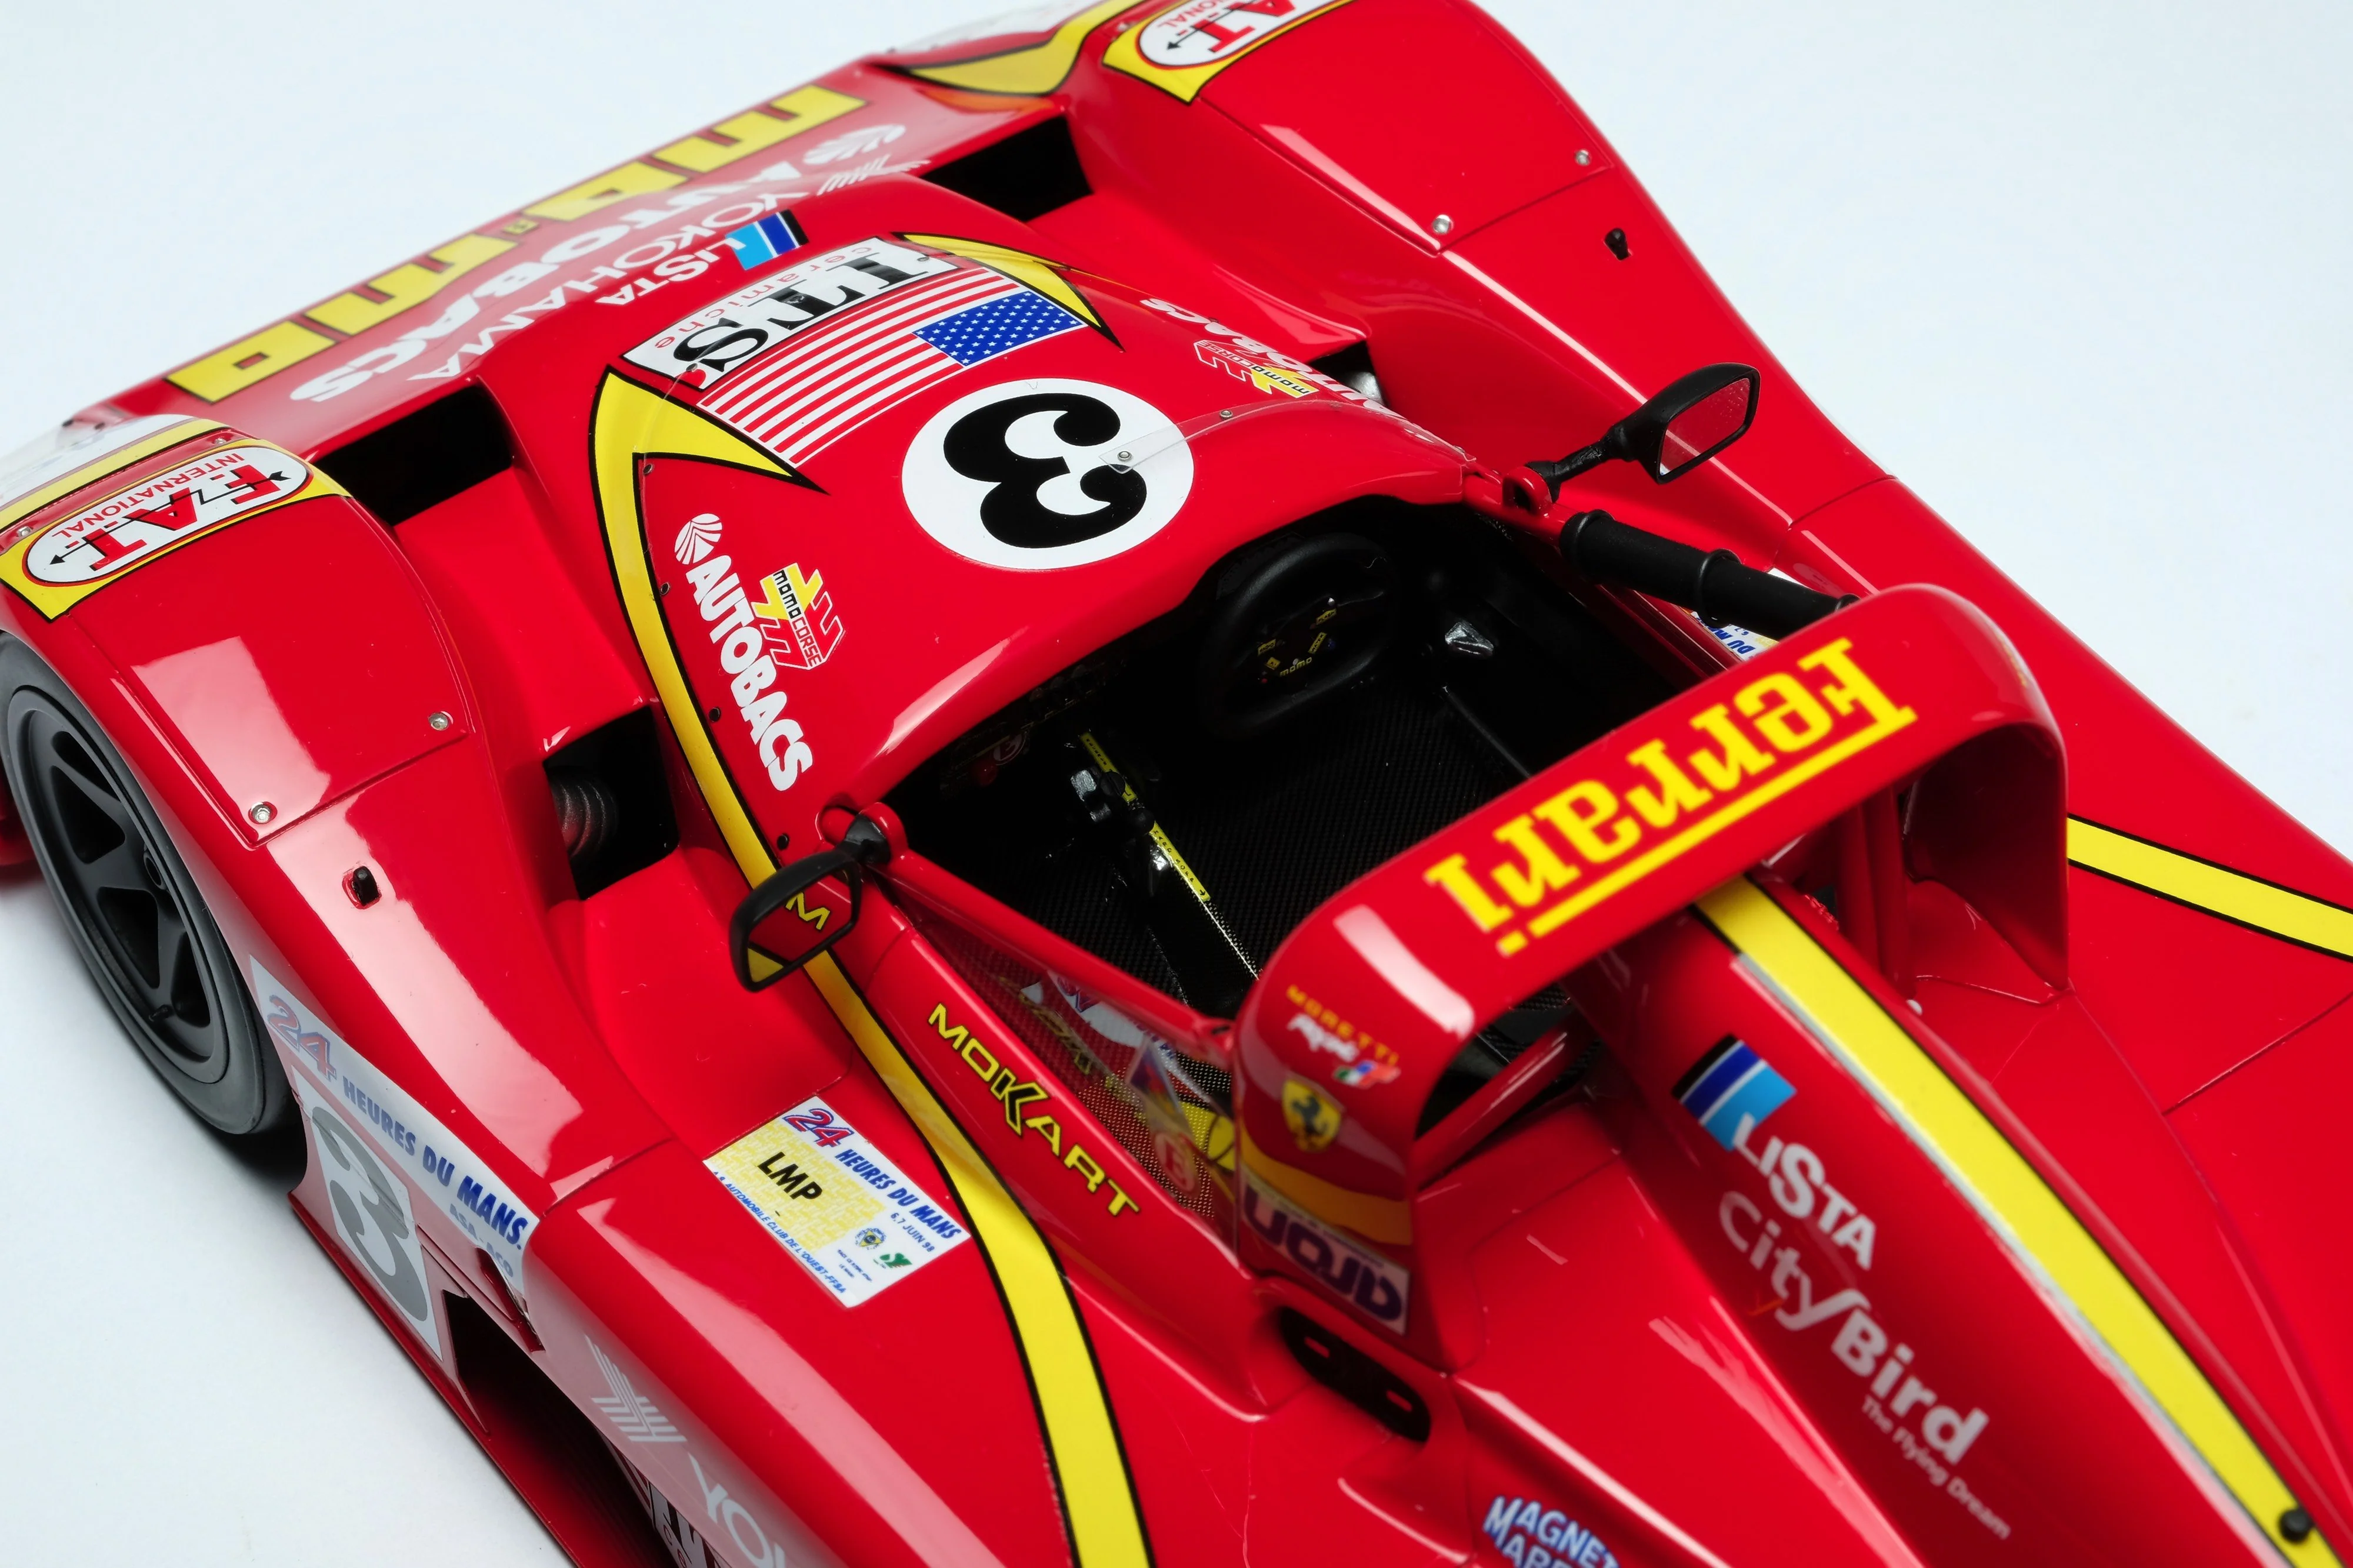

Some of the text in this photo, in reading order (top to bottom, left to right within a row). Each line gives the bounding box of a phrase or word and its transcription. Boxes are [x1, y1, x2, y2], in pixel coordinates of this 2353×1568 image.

[289, 160, 802, 403] AUTOBACS
[406, 191, 811, 381] YOKOHAMA
[594, 237, 748, 306] LISTA
[654, 246, 872, 349] ceramiche
[1139, 298, 1408, 421] AUTOBACS
[52, 452, 246, 538] INTERNATIONAL
[943, 392, 1147, 549] 3
[685, 554, 814, 792] AUTOBACS
[1423, 636, 1918, 958] Ferrari
[266, 994, 337, 1082] 24
[342, 1076, 417, 1156] HEURES
[422, 1145, 455, 1187] DU
[926, 1001, 1141, 1219] MOKART
[312, 1106, 428, 1322] 3
[725, 1183, 770, 1222] AUTOMOBILE
[767, 1221, 789, 1239] CLUB
[785, 1238, 799, 1249] DE
[757, 1151, 824, 1200] LMP
[782, 1107, 855, 1148] 24
[834, 1148, 897, 1190] HEURES
[886, 1187, 919, 1207] DU
[909, 1204, 962, 1239] MANS
[902, 1225, 926, 1243] JUIN
[921, 1242, 935, 1253] 98
[1731, 1112, 1877, 1271] LISTA
